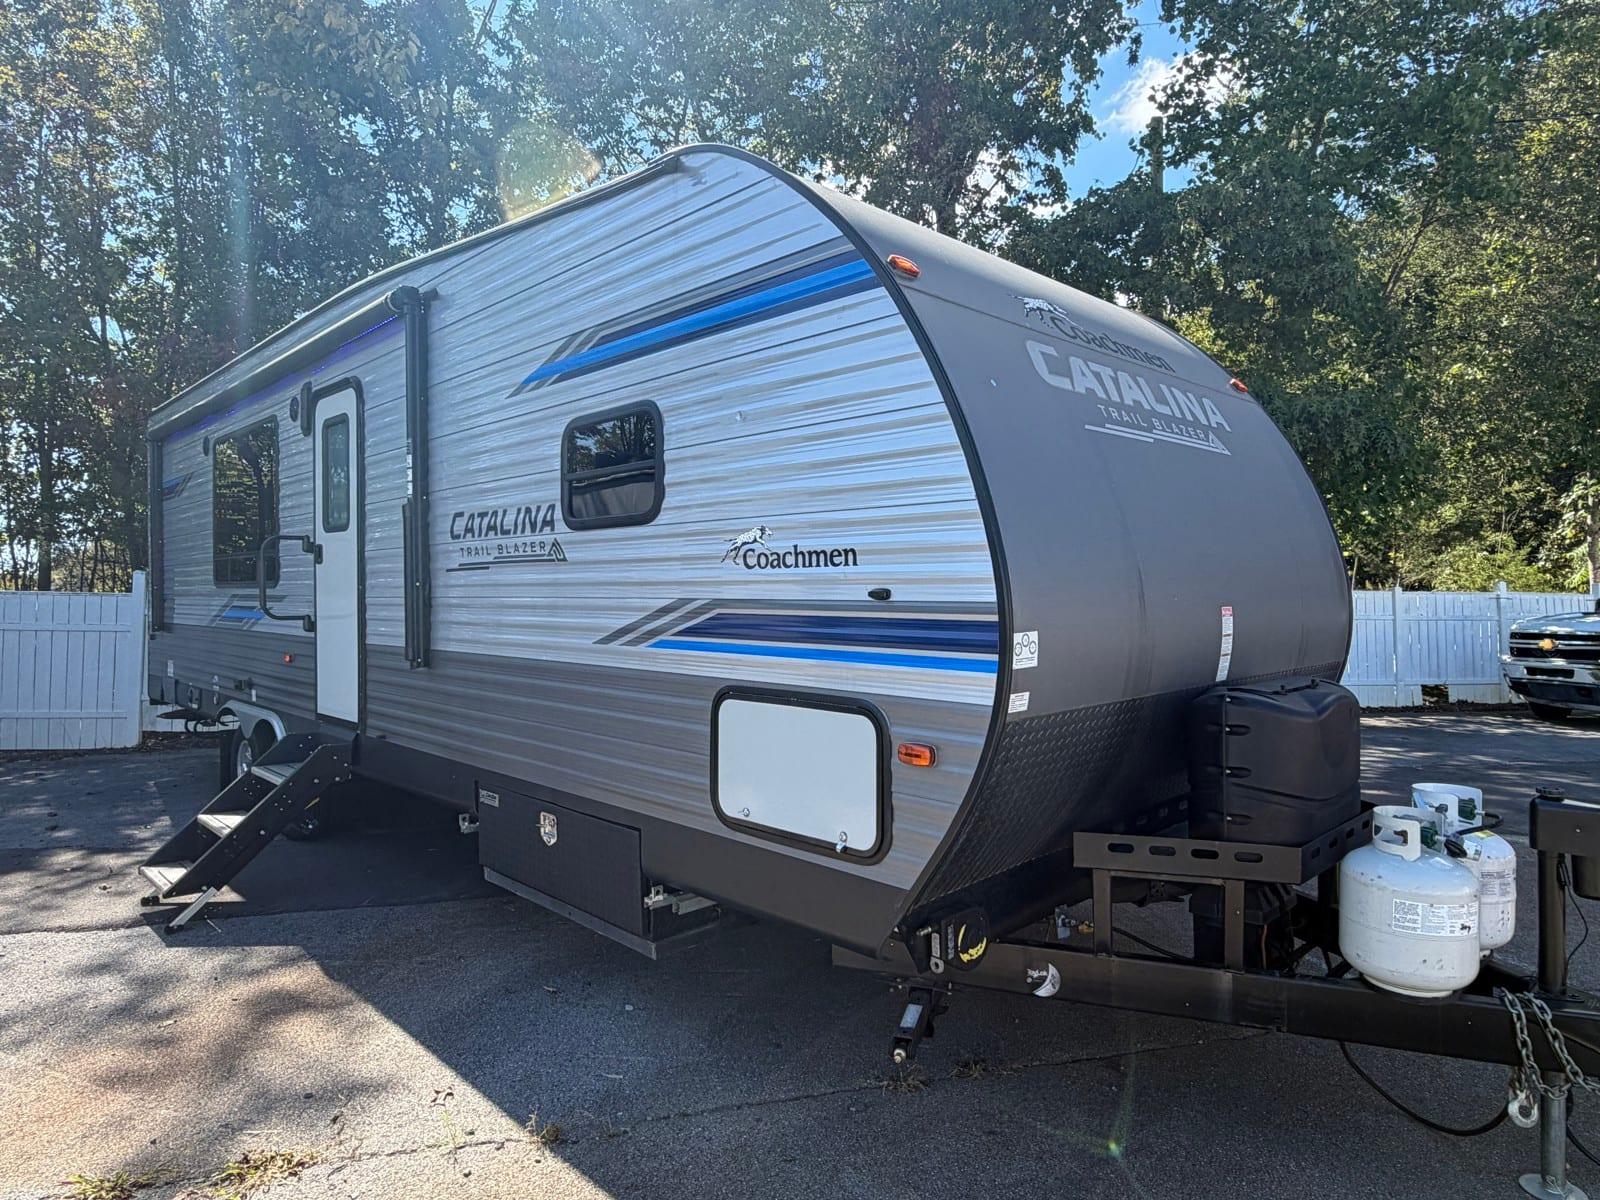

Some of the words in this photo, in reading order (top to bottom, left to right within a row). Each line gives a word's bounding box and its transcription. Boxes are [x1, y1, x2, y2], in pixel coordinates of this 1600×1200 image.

[1050, 316, 1176, 373] Coachmen
[1026, 339, 1232, 432] CATALINA
[1097, 404, 1148, 427] TRAIL
[1153, 418, 1207, 441] BLAZER
[449, 503, 556, 540] CATALINA
[460, 545, 492, 558] TRAIL
[497, 541, 546, 555] BLAZER
[743, 544, 858, 570] Coachmen
